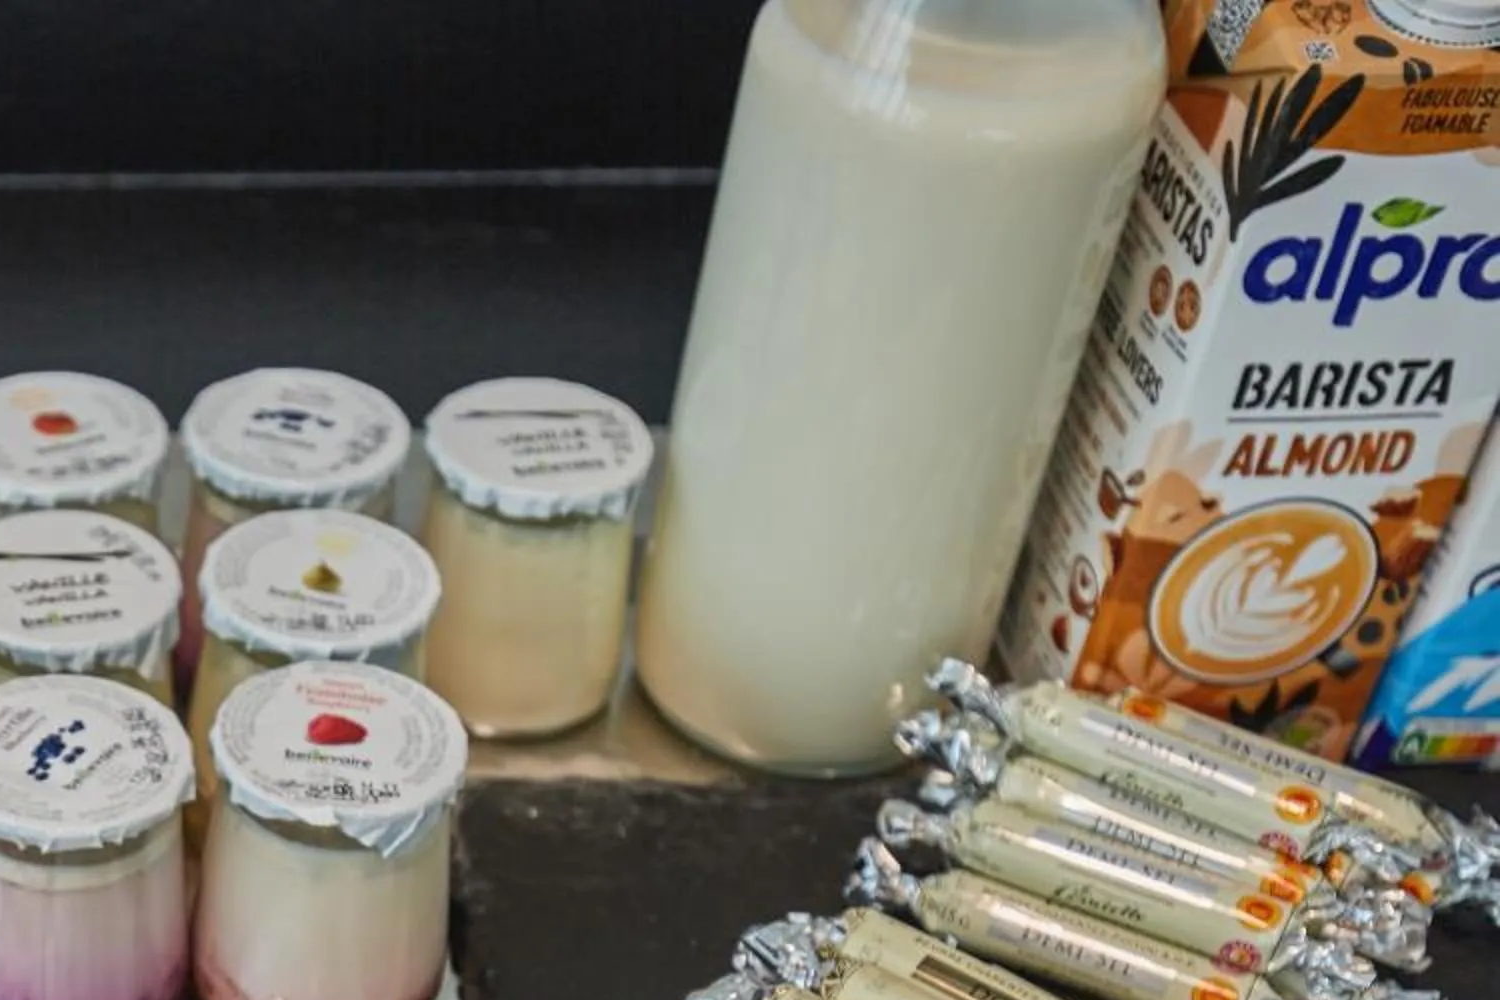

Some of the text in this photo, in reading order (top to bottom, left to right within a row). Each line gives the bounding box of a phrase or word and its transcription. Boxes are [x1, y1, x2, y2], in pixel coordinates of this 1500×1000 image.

[1402, 113, 1491, 134] FOAMABLE
[1141, 137, 1214, 265] ARISTAS
[1231, 359, 1455, 411] BARISTA
[1223, 429, 1415, 478] ALMOND
